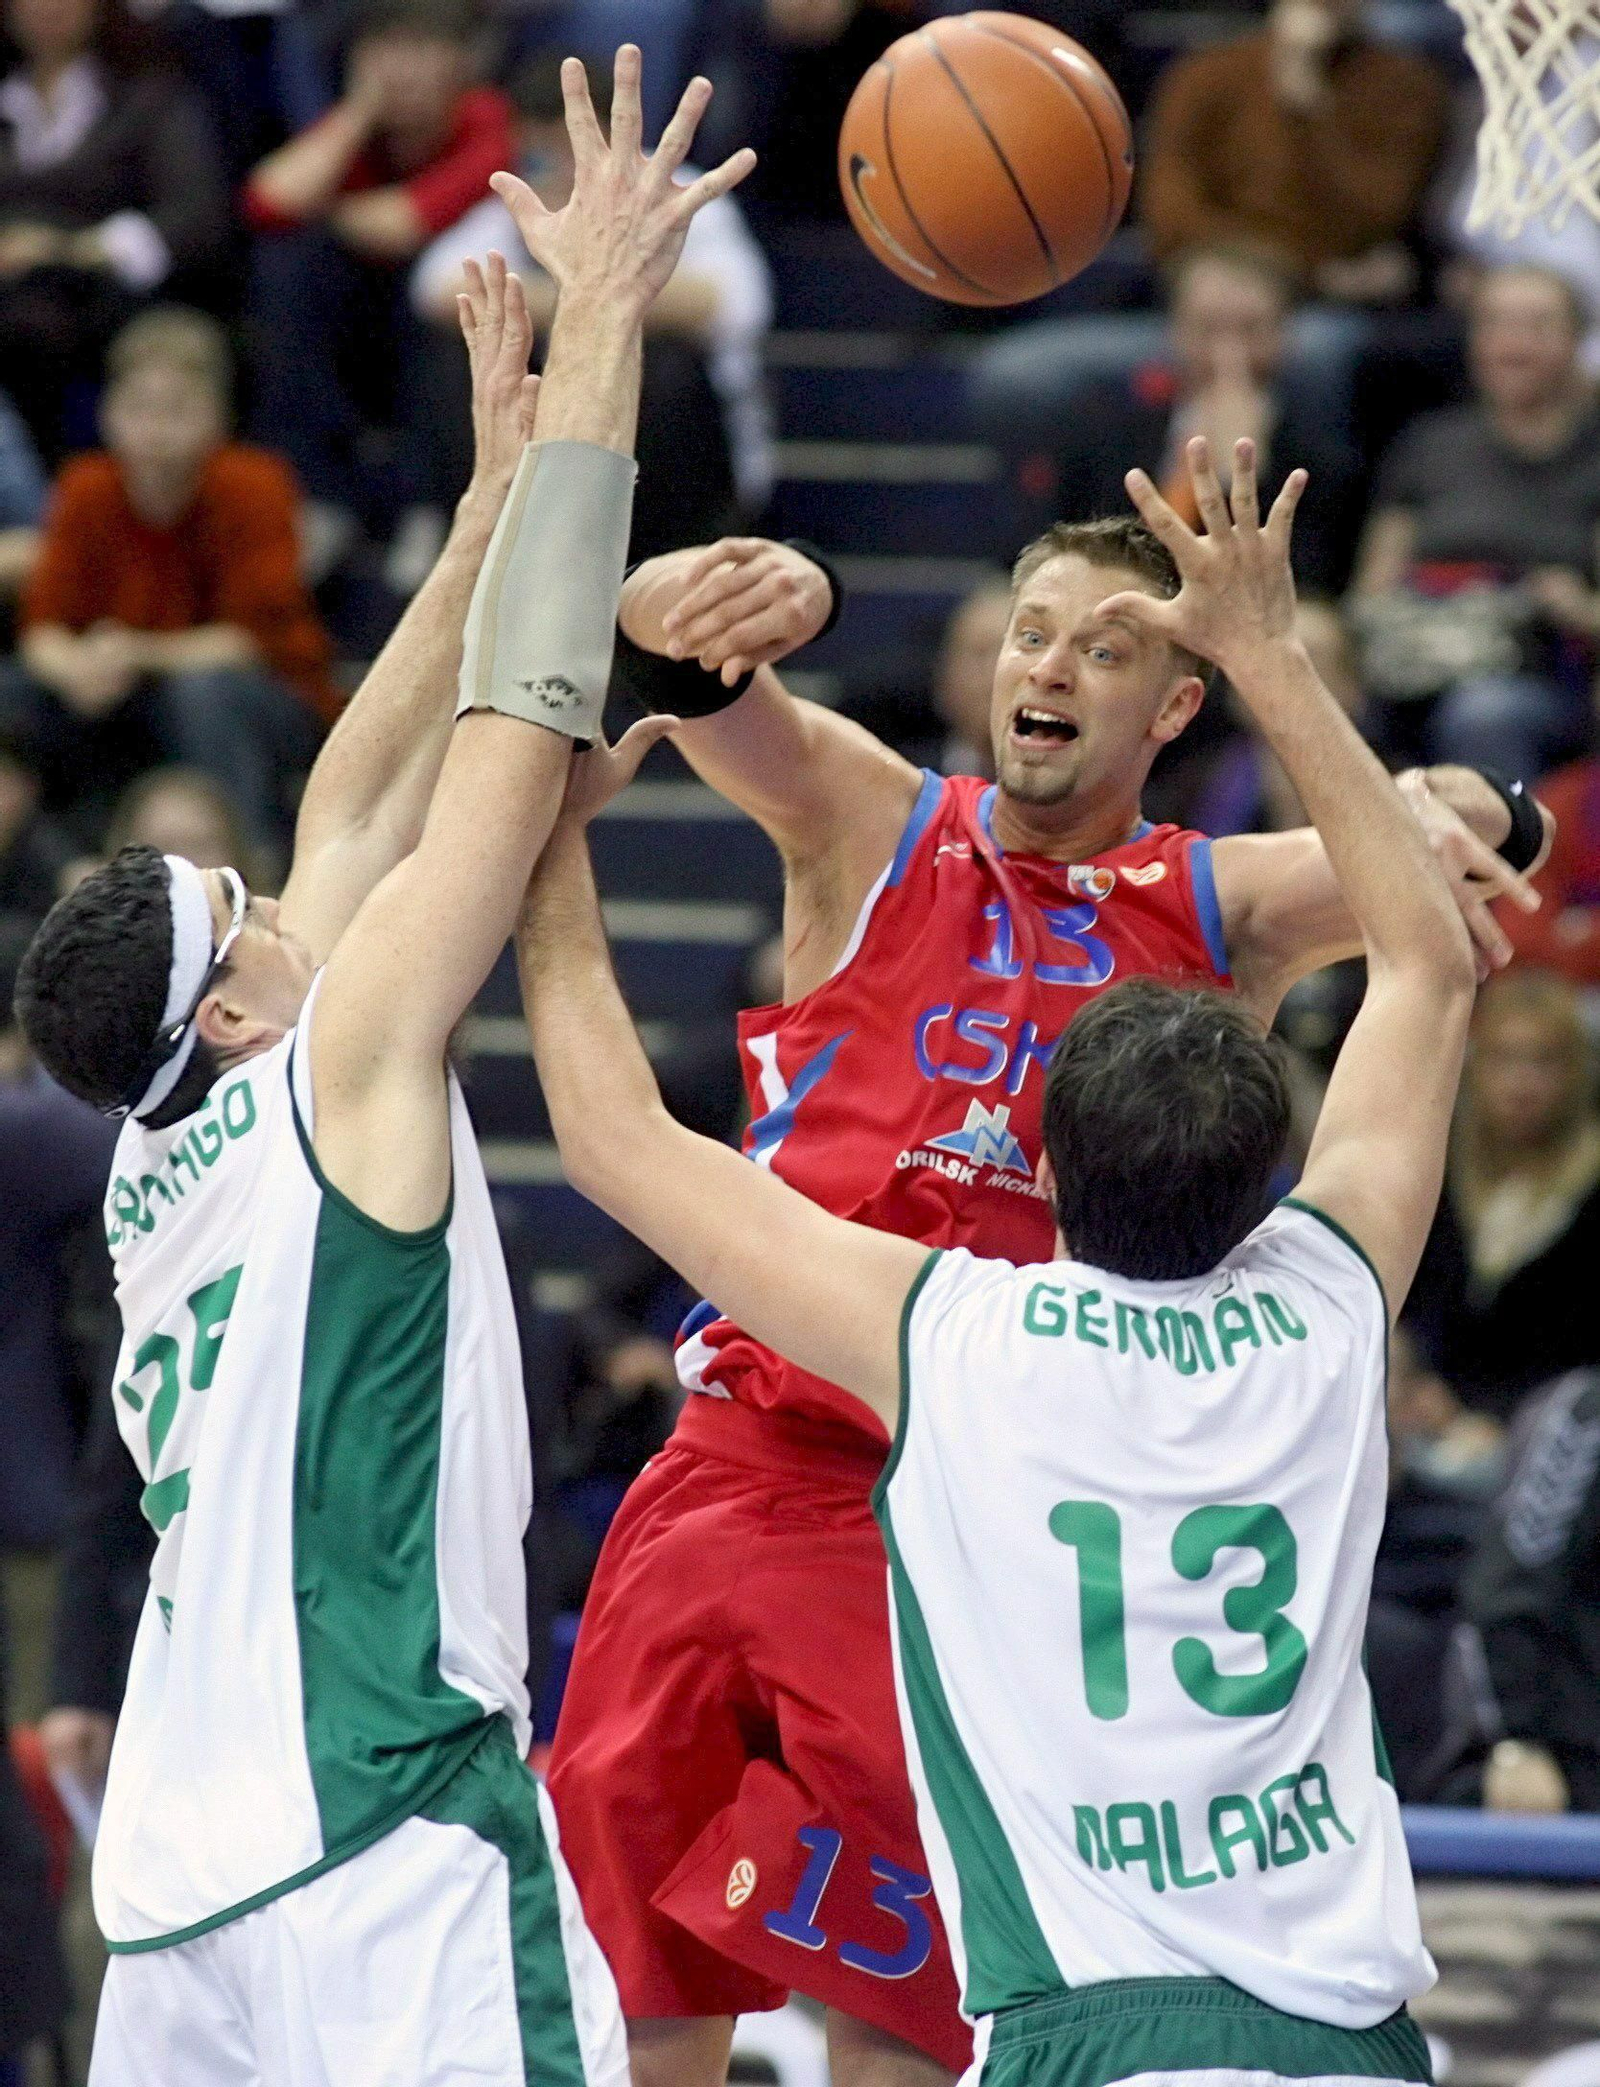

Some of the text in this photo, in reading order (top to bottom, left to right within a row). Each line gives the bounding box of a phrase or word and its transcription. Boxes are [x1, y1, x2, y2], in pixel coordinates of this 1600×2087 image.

[969, 900, 1114, 987] 13
[1023, 1281, 1308, 1376] GERMÁN
[1048, 1499, 1309, 1722] 13
[762, 1826, 932, 1980] 13
